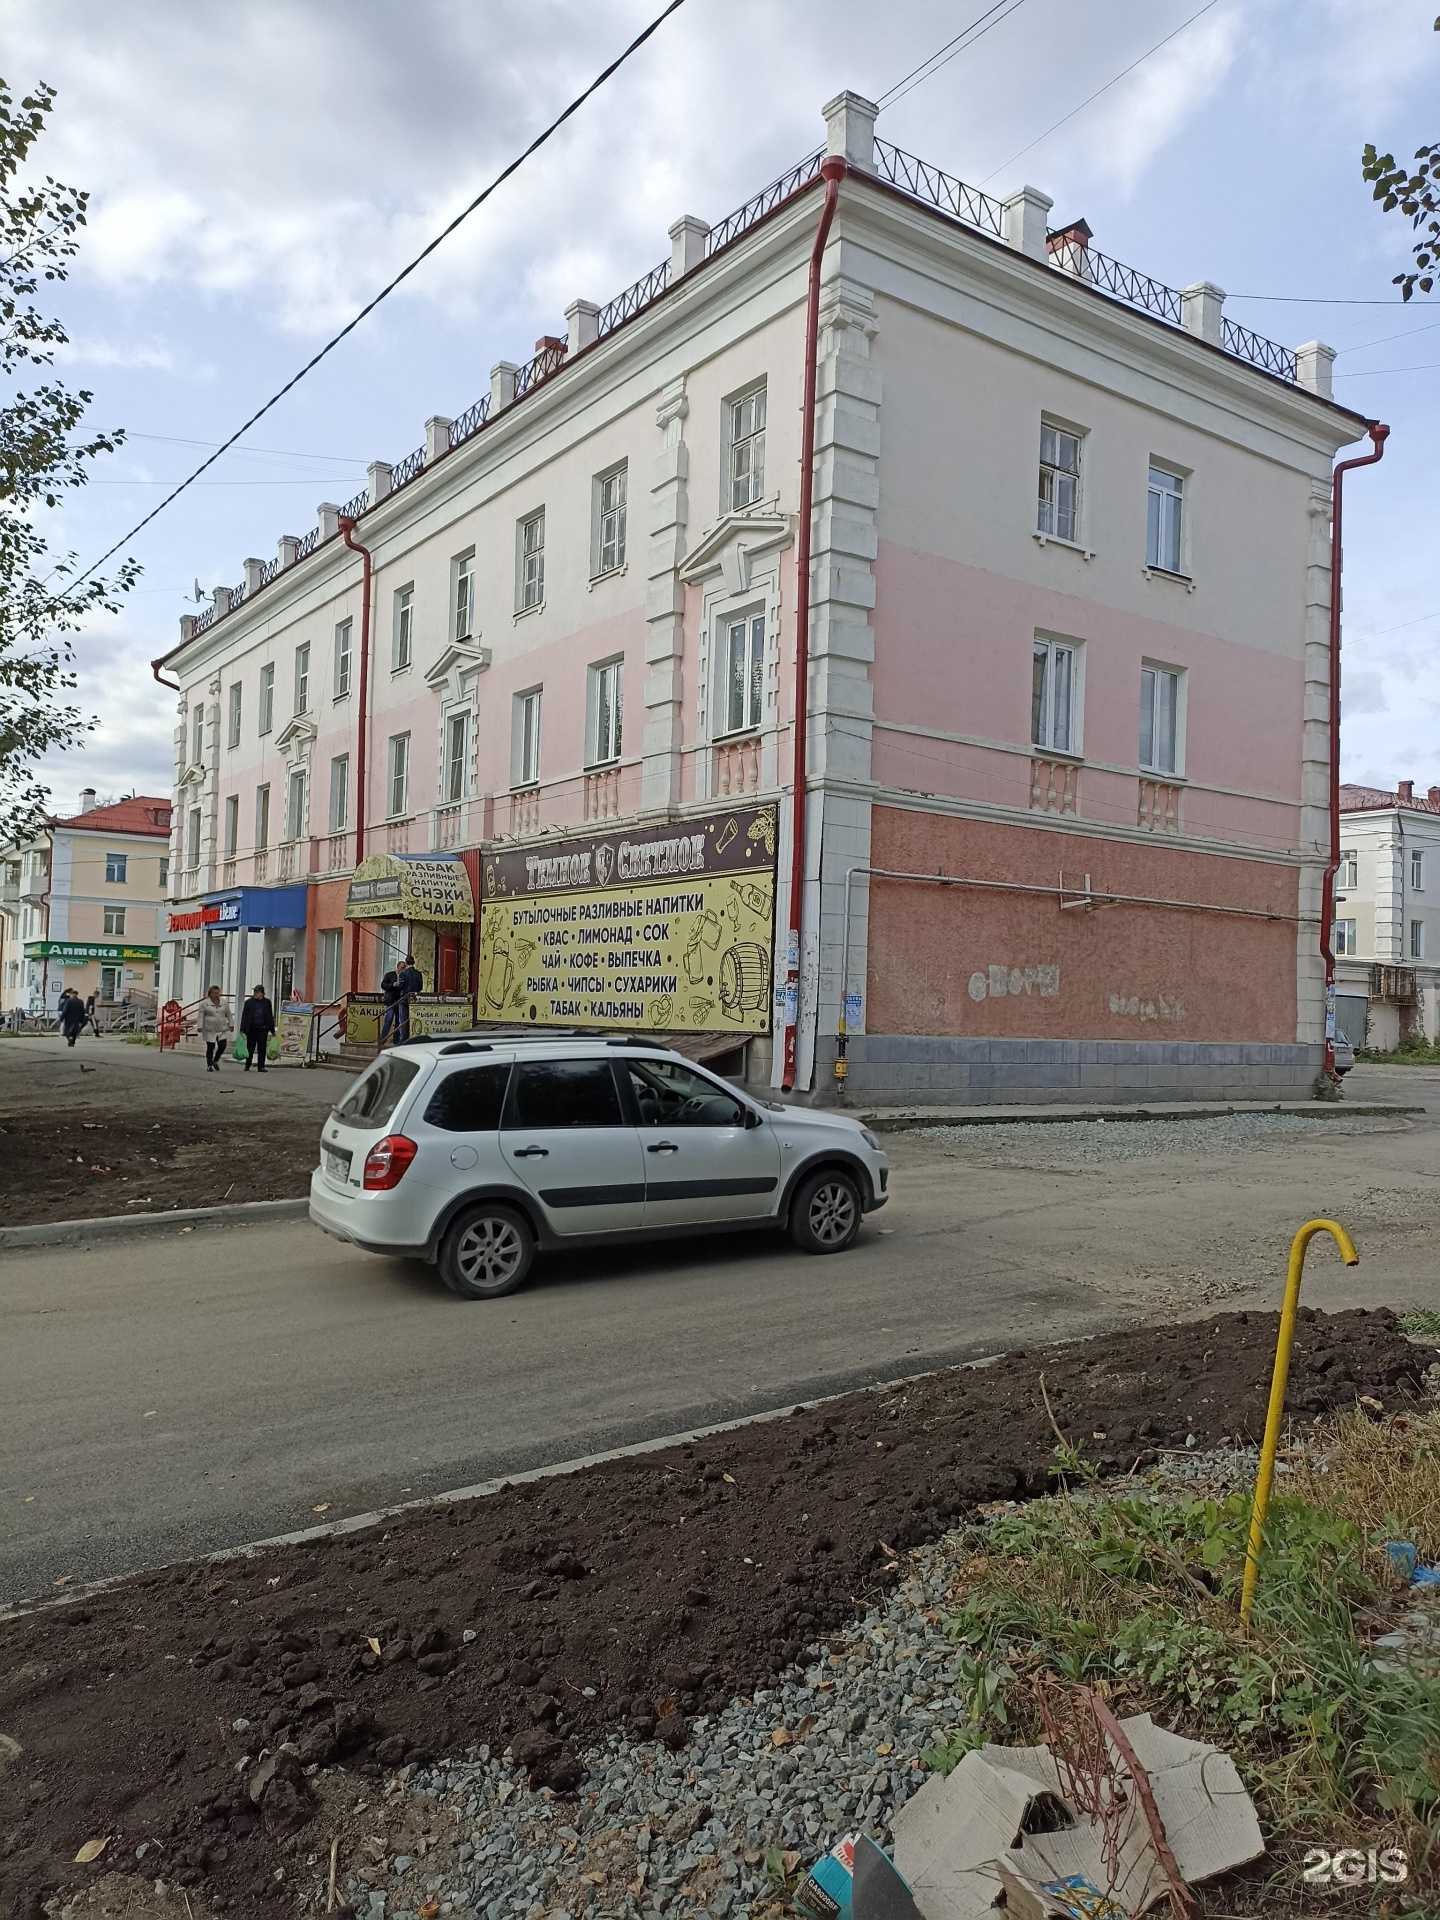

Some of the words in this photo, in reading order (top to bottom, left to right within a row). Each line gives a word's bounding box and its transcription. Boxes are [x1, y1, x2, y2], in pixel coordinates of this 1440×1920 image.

[406, 870, 460, 881] РАЗЛИВНЫЕ
[407, 862, 455, 873] ТАБАК
[414, 879, 456, 887] НАПИТКИ
[410, 886, 464, 900] СНЭКИ
[423, 901, 455, 916] ЧАЙ
[513, 905, 577, 925] БУТЫЛОЧНЫЕ
[579, 899, 643, 920] РАЗЛИВНЫЕ
[645, 894, 704, 916] НАПИТКИ
[543, 930, 569, 946] КВАС
[577, 926, 633, 945] ЛИМОНАД
[643, 923, 670, 941] СОК
[542, 950, 561, 969] ЧАЙ
[569, 952, 599, 968] КОФЕ
[607, 949, 662, 968] ВЫПЕЧКА
[527, 977, 559, 992] РЫБКА
[567, 976, 605, 993] ЧИПСЫ
[614, 976, 677, 993] СУХАРИКИ
[550, 1000, 581, 1016] ТАБАК
[590, 1001, 644, 1019] КАЛЬЯНЫ
